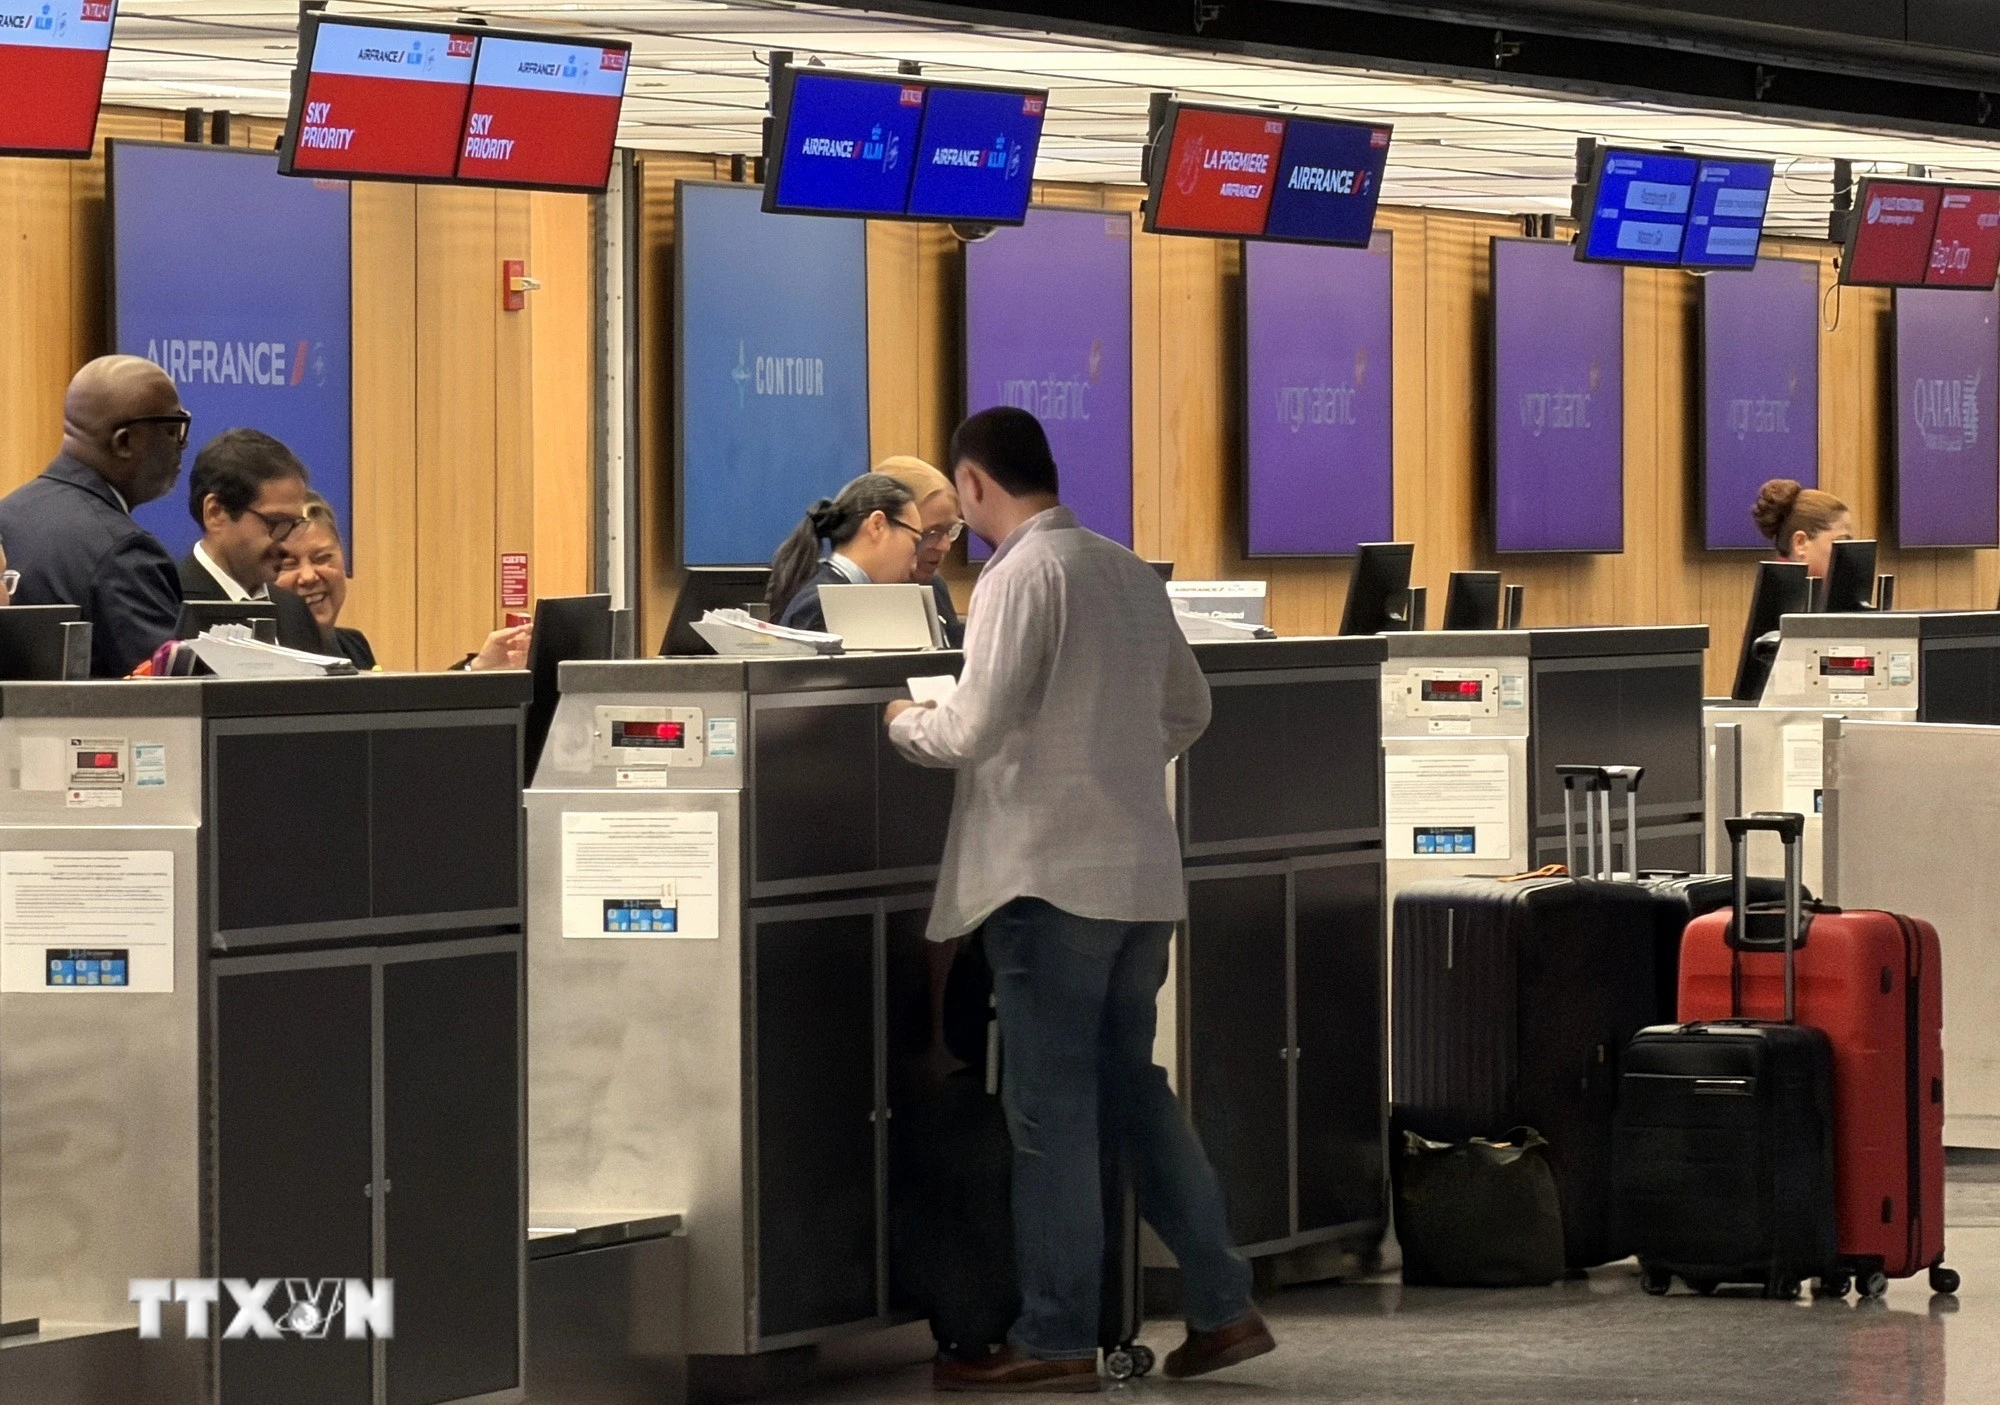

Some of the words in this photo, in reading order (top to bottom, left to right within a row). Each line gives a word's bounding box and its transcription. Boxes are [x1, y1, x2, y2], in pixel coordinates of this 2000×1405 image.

[305, 102, 331, 124] SKY
[469, 113, 493, 135] SKY
[300, 126, 355, 150] PRIORITY
[464, 137, 515, 160] PRIORITY
[802, 137, 854, 158] AIRFRANCE
[1203, 149, 1218, 169] LA
[1218, 150, 1270, 174] PREMIERE
[1288, 165, 1354, 194] AIRFRANCE
[147, 339, 285, 385] AIRFRANCE
[756, 356, 824, 396] CONTOUR
